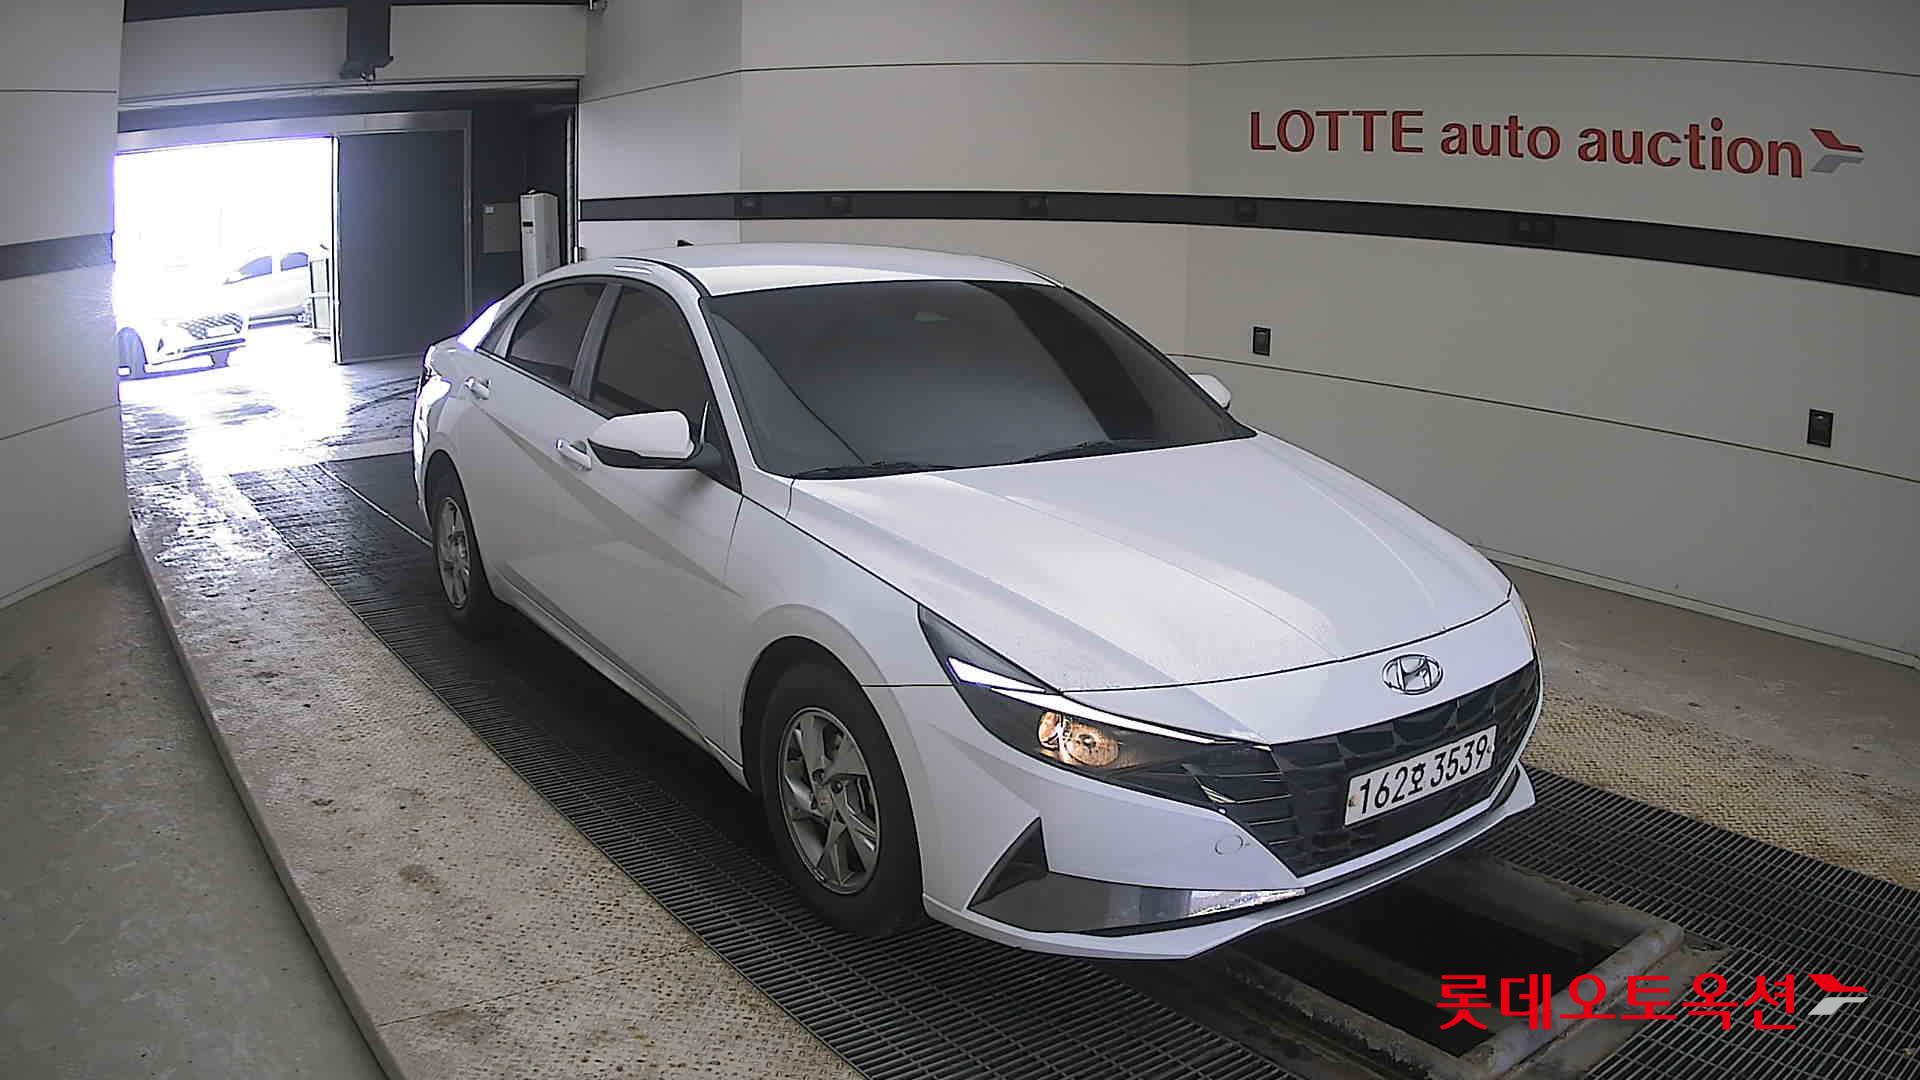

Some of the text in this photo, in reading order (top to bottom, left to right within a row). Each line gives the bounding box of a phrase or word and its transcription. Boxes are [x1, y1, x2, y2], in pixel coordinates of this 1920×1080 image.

[1250, 110, 1803, 178] LOTTE auto auction
[1359, 734, 1489, 815] 162호 3539
